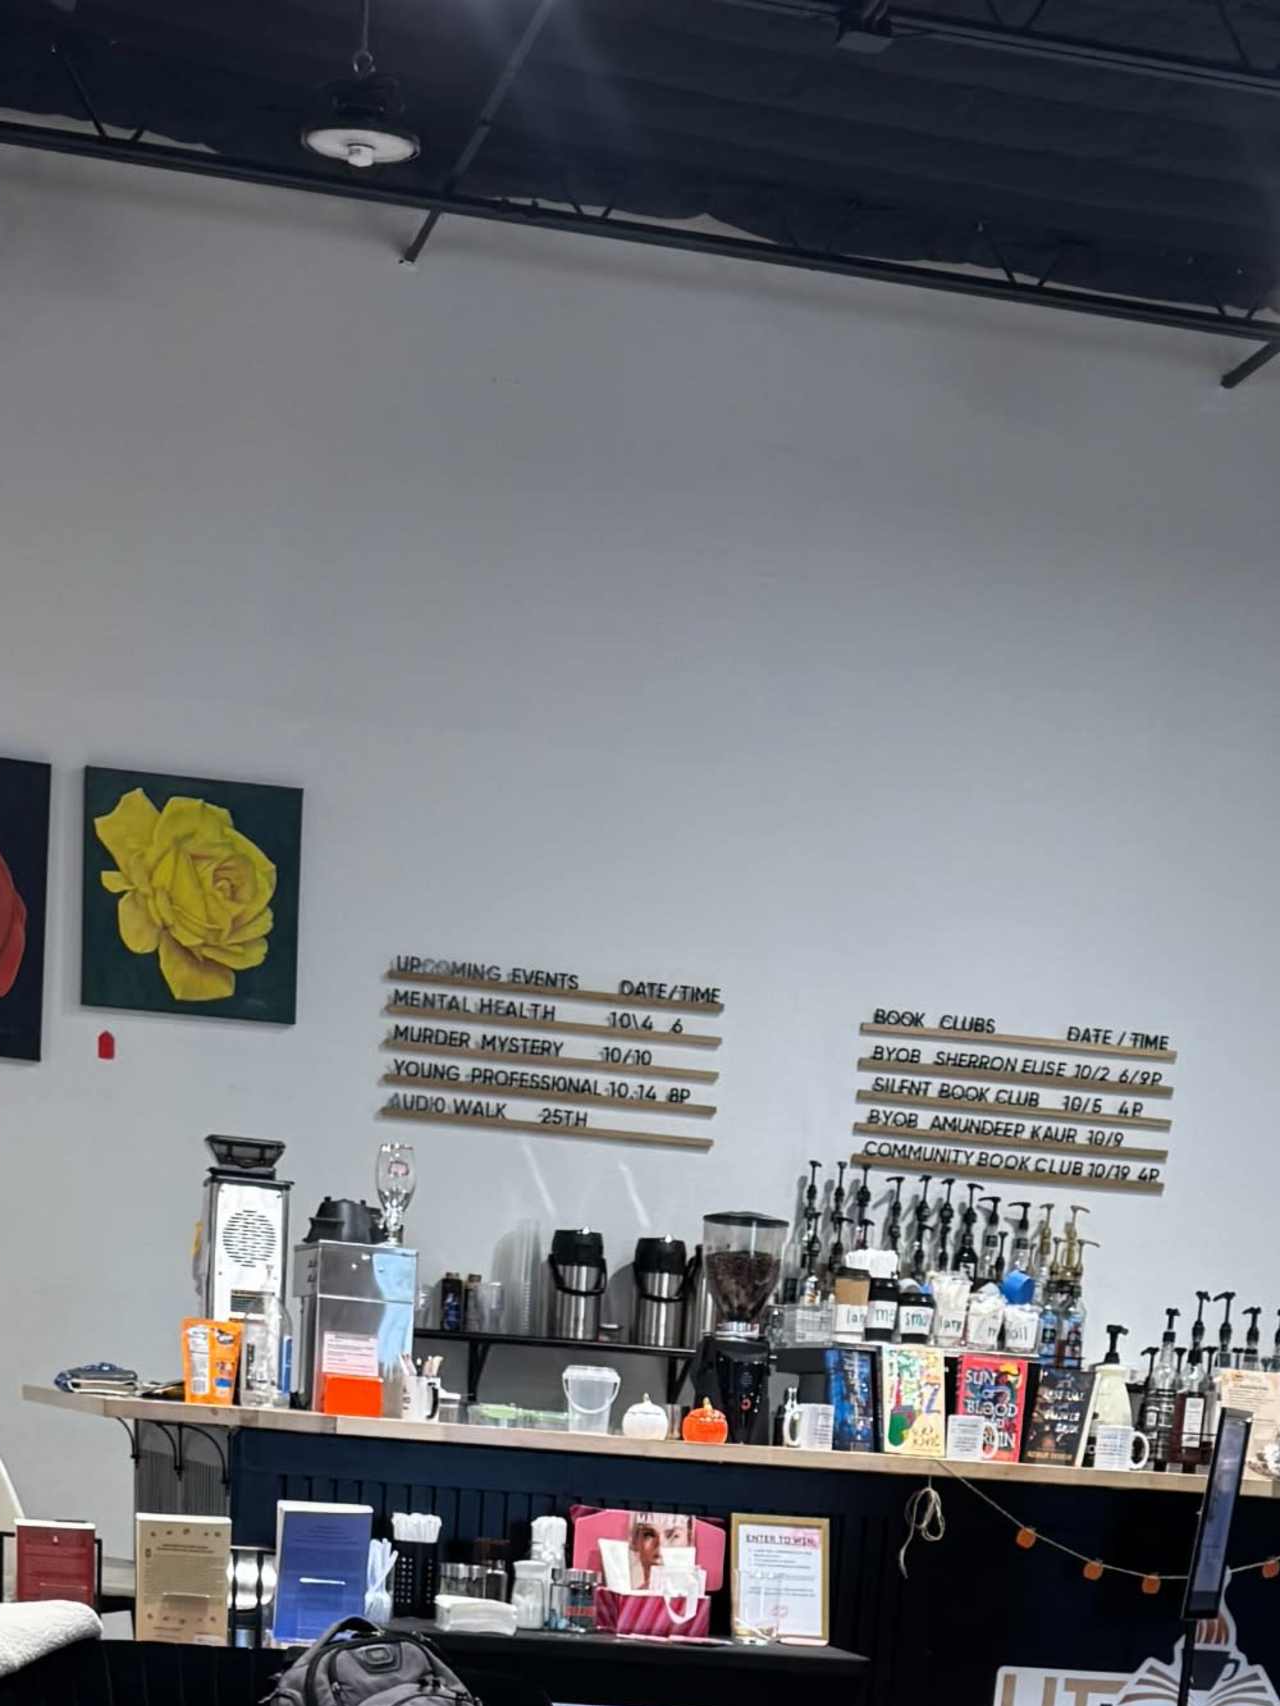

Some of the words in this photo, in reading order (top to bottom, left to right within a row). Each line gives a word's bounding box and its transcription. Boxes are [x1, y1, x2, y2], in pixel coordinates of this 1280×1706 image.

[395, 955, 502, 981] UPCOMING
[511, 968, 579, 990] EVENTS
[619, 979, 721, 1004] DATE/TIME
[393, 989, 472, 1013] MENTAL
[479, 998, 556, 1021] HEALTH
[671, 1018, 683, 1034] 6
[873, 1008, 926, 1028] BOOK
[939, 1014, 996, 1034] CLUBS
[1067, 1026, 1113, 1045] DATE
[1130, 1032, 1170, 1051] TIME
[393, 1024, 471, 1048] MURDER
[481, 1034, 564, 1057] MYSTERY
[602, 1046, 652, 1066] 10/10
[872, 1045, 921, 1064] BYOB
[933, 1051, 1018, 1072] SHERRON
[1021, 1059, 1067, 1077] ELISE
[1074, 1064, 1110, 1081] 10/2
[393, 1059, 461, 1081] YOUNG
[471, 1067, 600, 1096] PROFESSIONAL
[872, 1076, 932, 1096] SILENT
[938, 1083, 991, 1102] BOOK
[995, 1089, 1040, 1107] CLUB
[1118, 1101, 1143, 1117] 4P
[387, 1092, 446, 1113] AUDIO
[453, 1098, 508, 1120] WALK
[541, 1107, 588, 1127] 25TH
[867, 1109, 919, 1128] BYOB
[930, 1115, 1025, 1138] AMUNDEEP
[1030, 1125, 1077, 1144] KAUR
[1087, 1129, 1124, 1147] 10/9
[863, 1141, 976, 1165] COMMUNITY
[977, 1150, 1031, 1173] BOOK
[1035, 1157, 1084, 1176] CLUB
[1088, 1162, 1131, 1181] 10/19
[1137, 1167, 1160, 1183] 4P
[965, 1368, 998, 1386] SUN
[963, 1397, 1018, 1418] BLOOD
[745, 1533, 776, 1545] ENTER
[779, 1537, 792, 1546] TO
